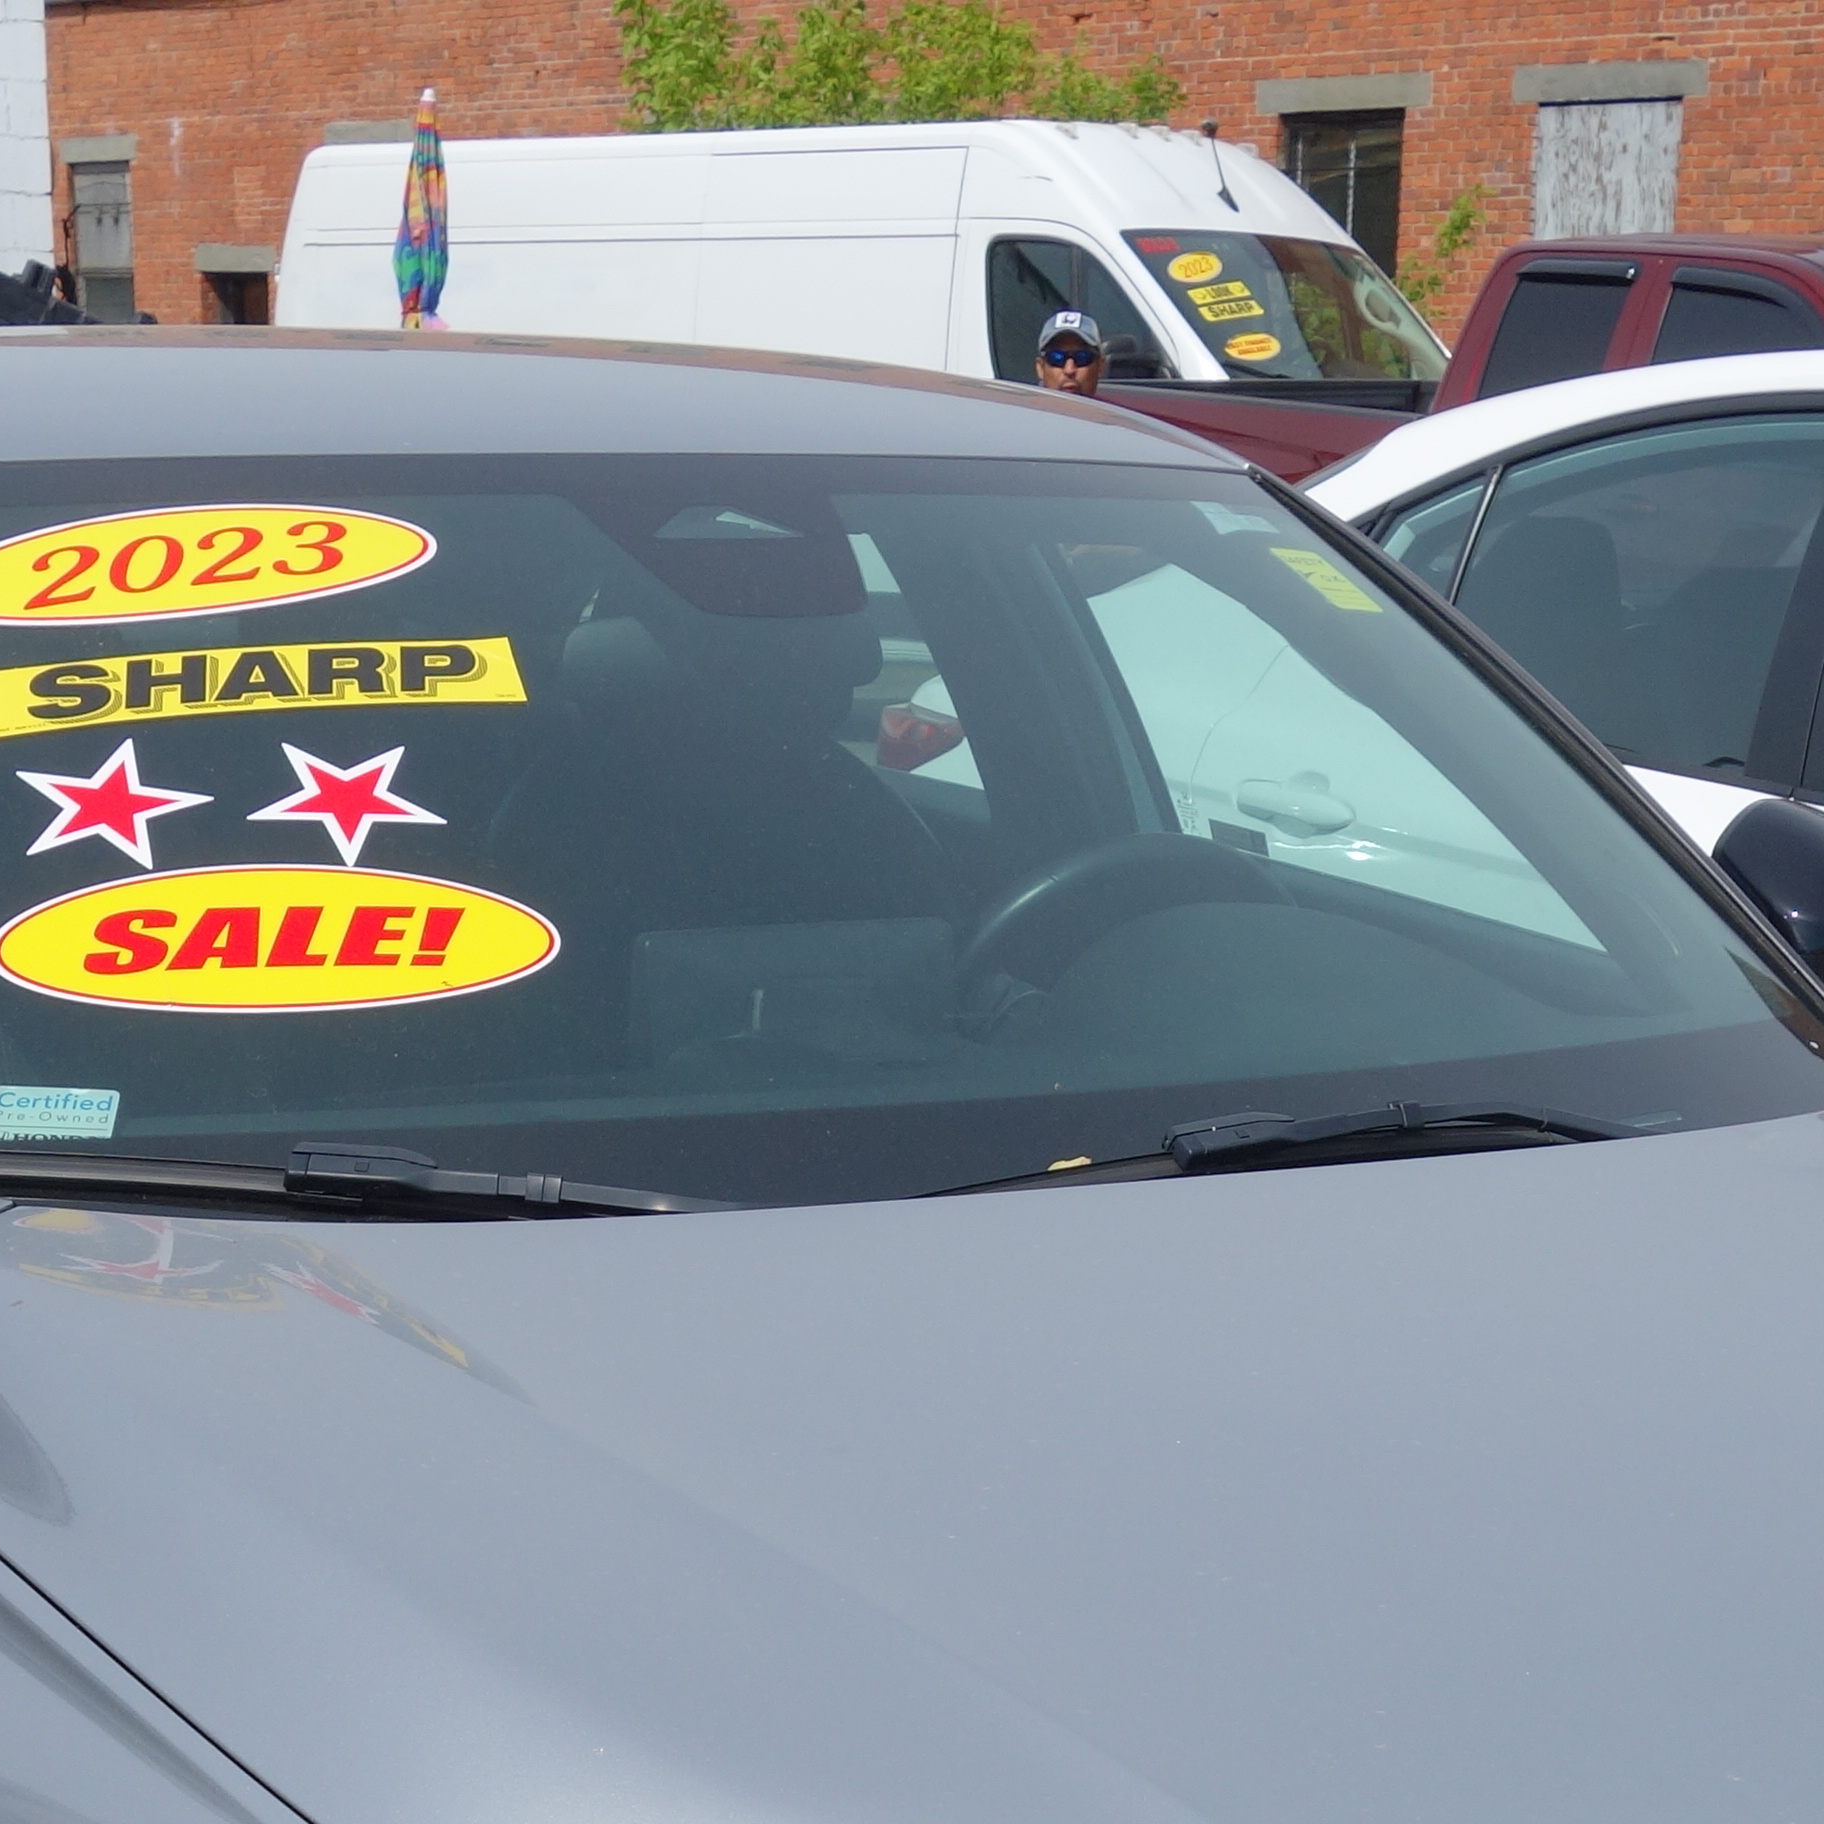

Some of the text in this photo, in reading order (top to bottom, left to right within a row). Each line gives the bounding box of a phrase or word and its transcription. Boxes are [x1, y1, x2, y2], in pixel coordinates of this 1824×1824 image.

[1179, 257, 1213, 278] 2023
[1208, 303, 1253, 318] SHARP
[22, 520, 349, 611] 2023
[26, 644, 484, 722] SHARP
[83, 905, 467, 976] SALE!
